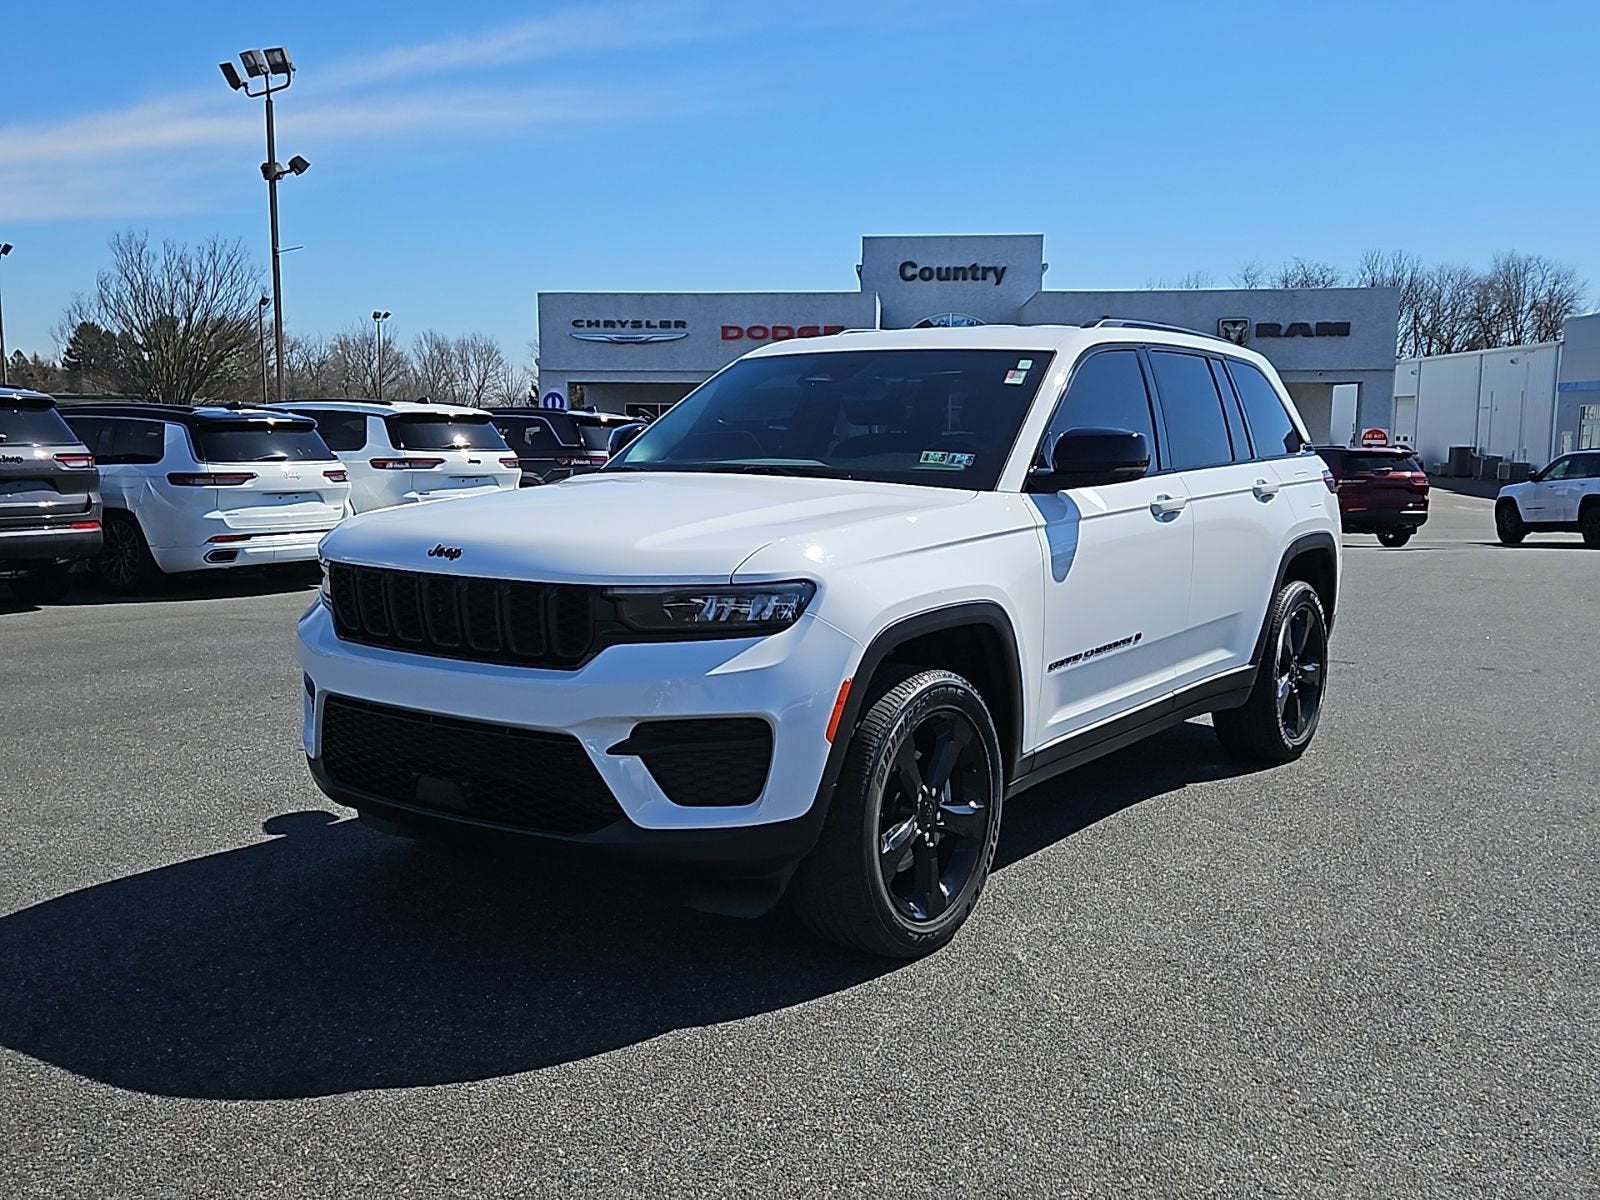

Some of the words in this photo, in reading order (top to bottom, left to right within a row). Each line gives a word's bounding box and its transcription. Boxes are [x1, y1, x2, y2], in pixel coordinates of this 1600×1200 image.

[899, 261, 1007, 286] Country
[571, 319, 687, 329] CHRYSLER
[720, 325, 845, 340] DODGE
[1255, 321, 1351, 338] RAM
[427, 543, 463, 561] Jeep
